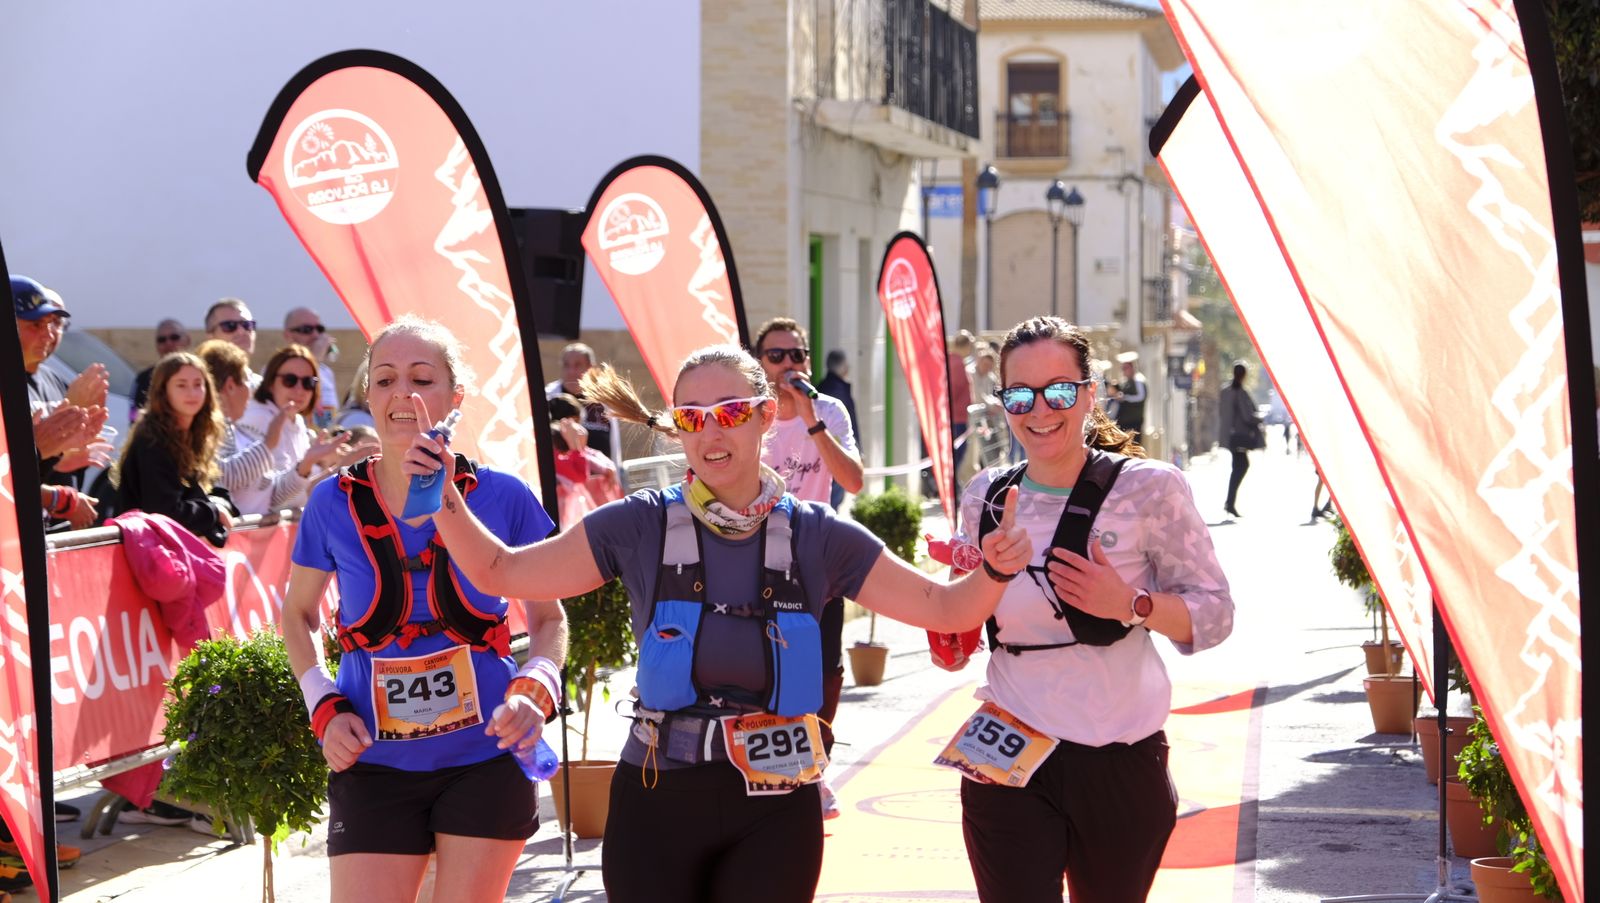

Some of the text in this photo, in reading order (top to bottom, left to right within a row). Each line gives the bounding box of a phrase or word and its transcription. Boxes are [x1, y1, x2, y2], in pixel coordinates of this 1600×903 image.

[773, 600, 803, 610] EVADICT
[386, 671, 456, 705] 243
[747, 726, 811, 762] 292
[963, 716, 1026, 758] 359
